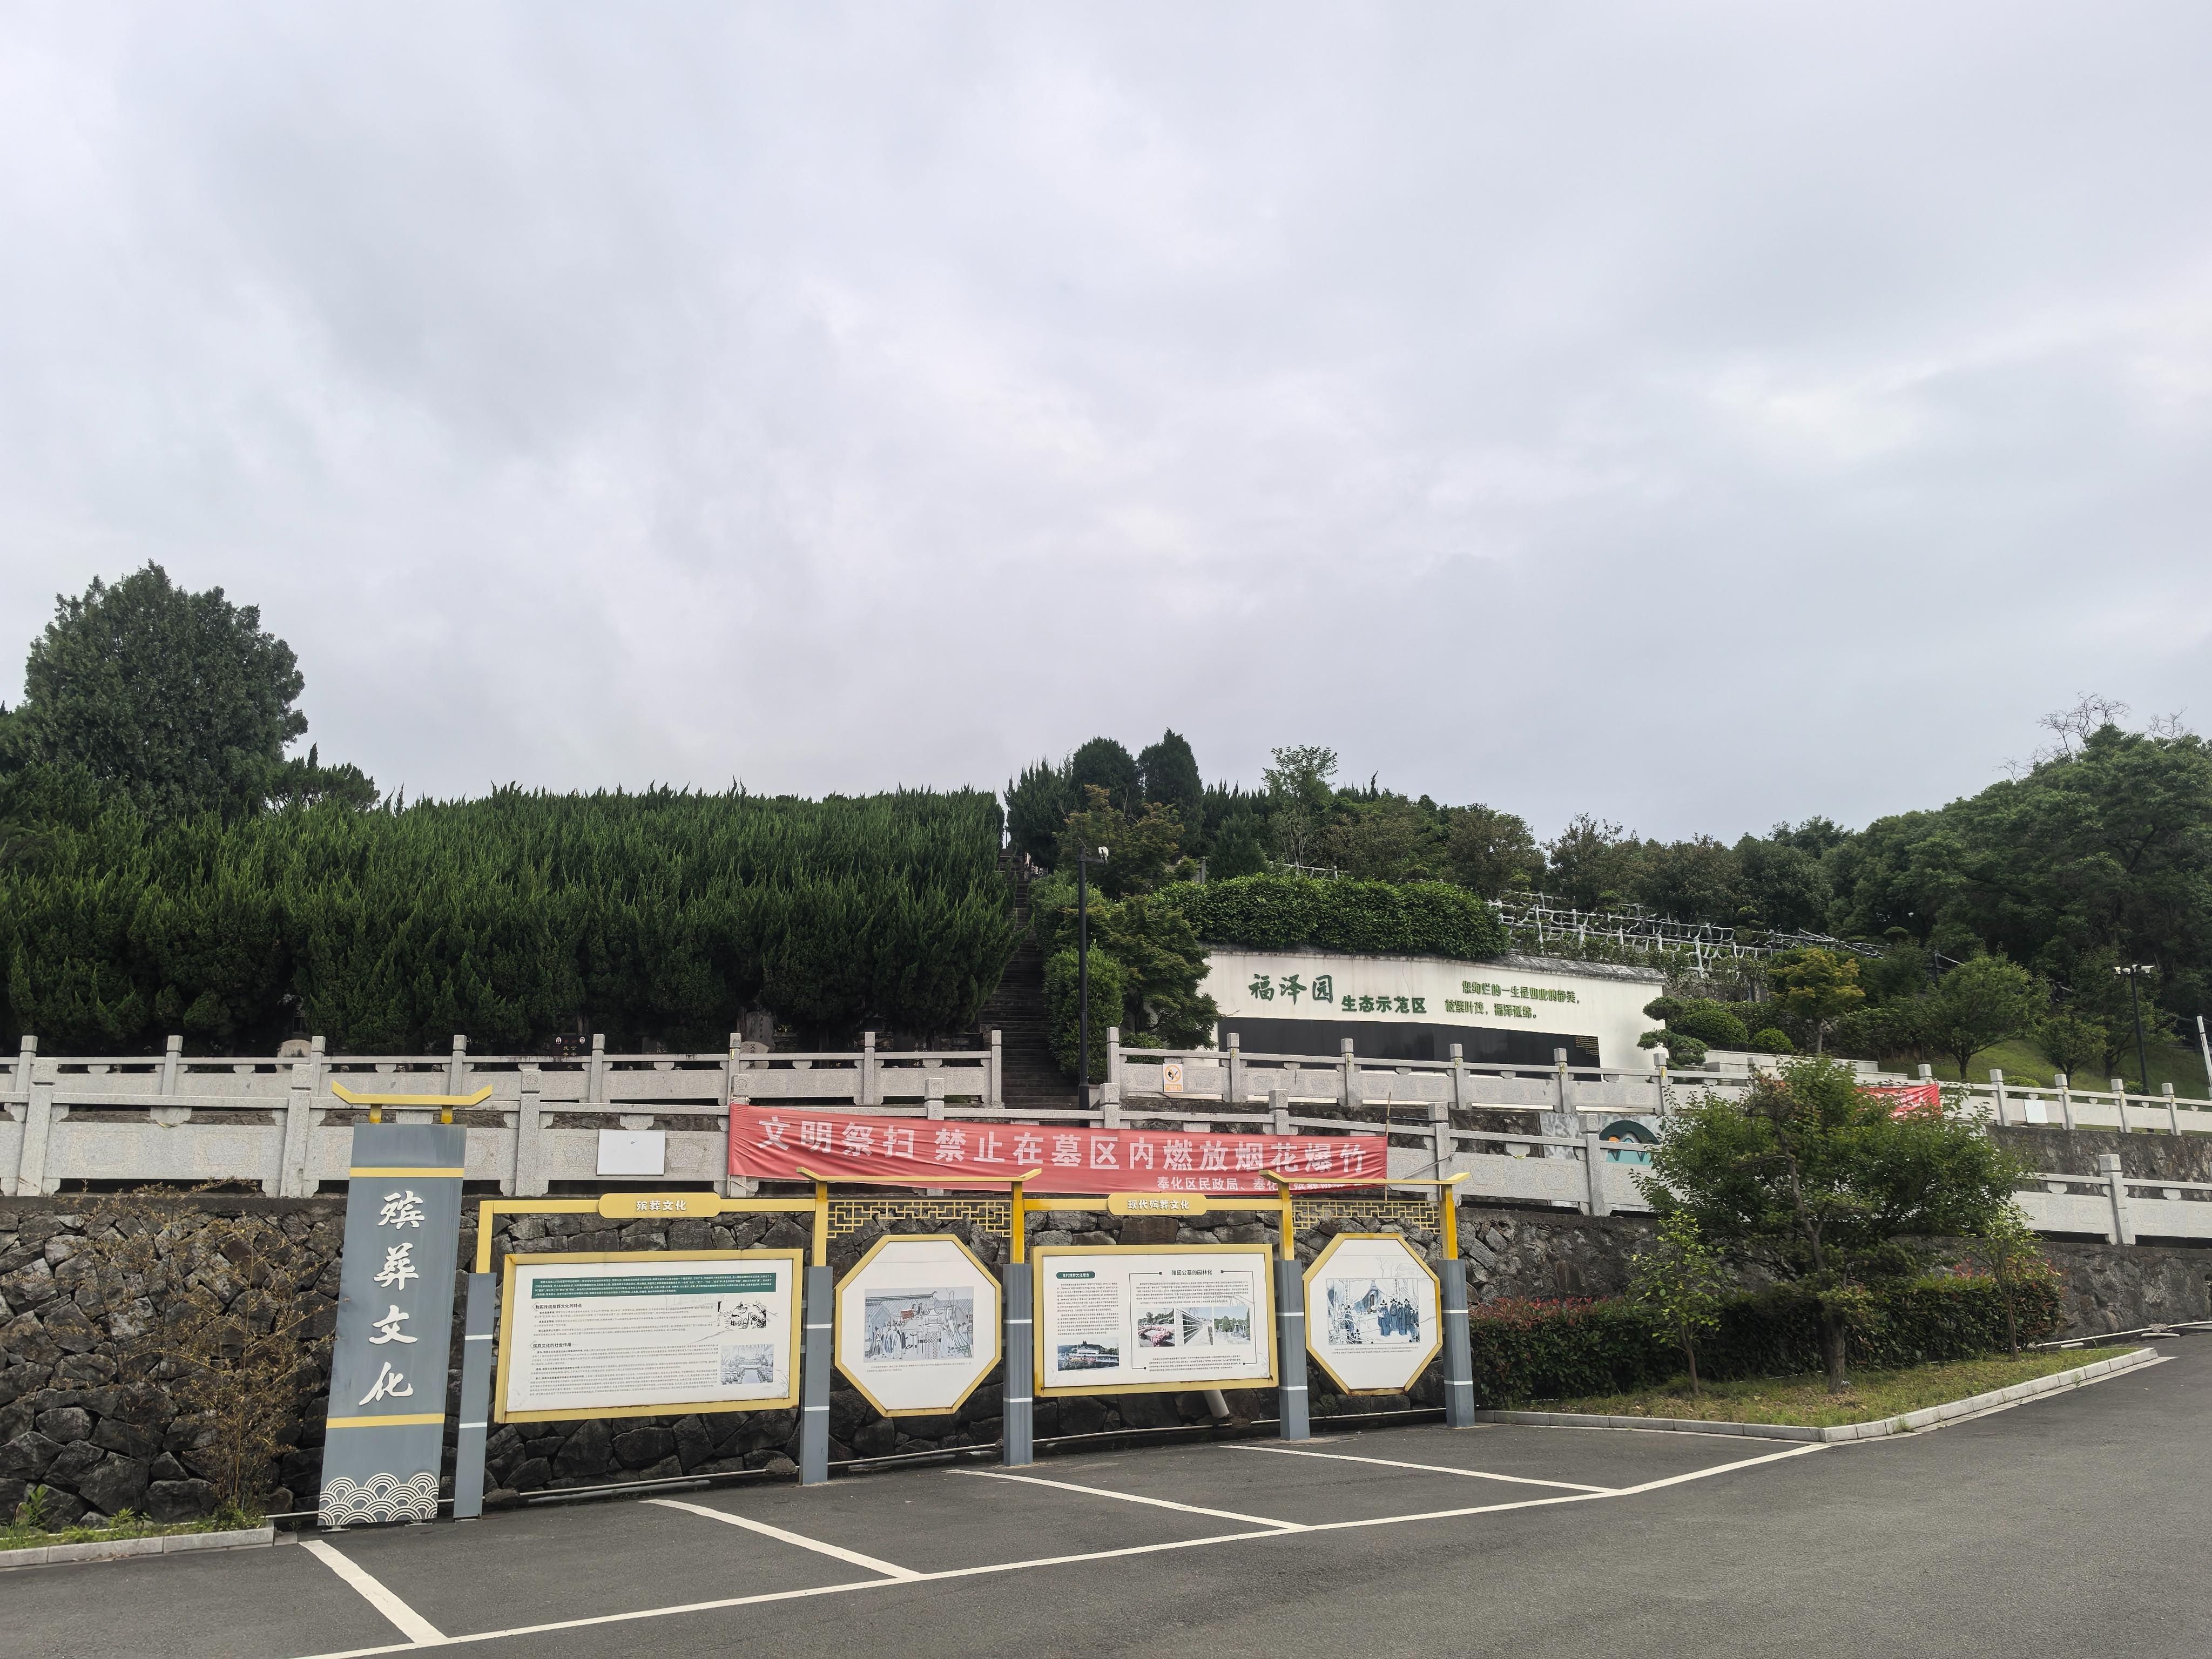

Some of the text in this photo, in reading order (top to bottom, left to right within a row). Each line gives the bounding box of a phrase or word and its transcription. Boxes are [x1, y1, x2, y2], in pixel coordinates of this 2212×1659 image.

[1249, 974, 1333, 1005] 福泽园
[1341, 995, 1427, 1014] 生态示范区
[757, 1115, 1366, 1173] 文明祭扫 禁止在墓区内燃放烟花爆竹
[636, 1200, 687, 1211] 殡葬文化
[1127, 1199, 1190, 1210] 现代殡葬文化
[359, 1190, 425, 1406] 殡葬文化
